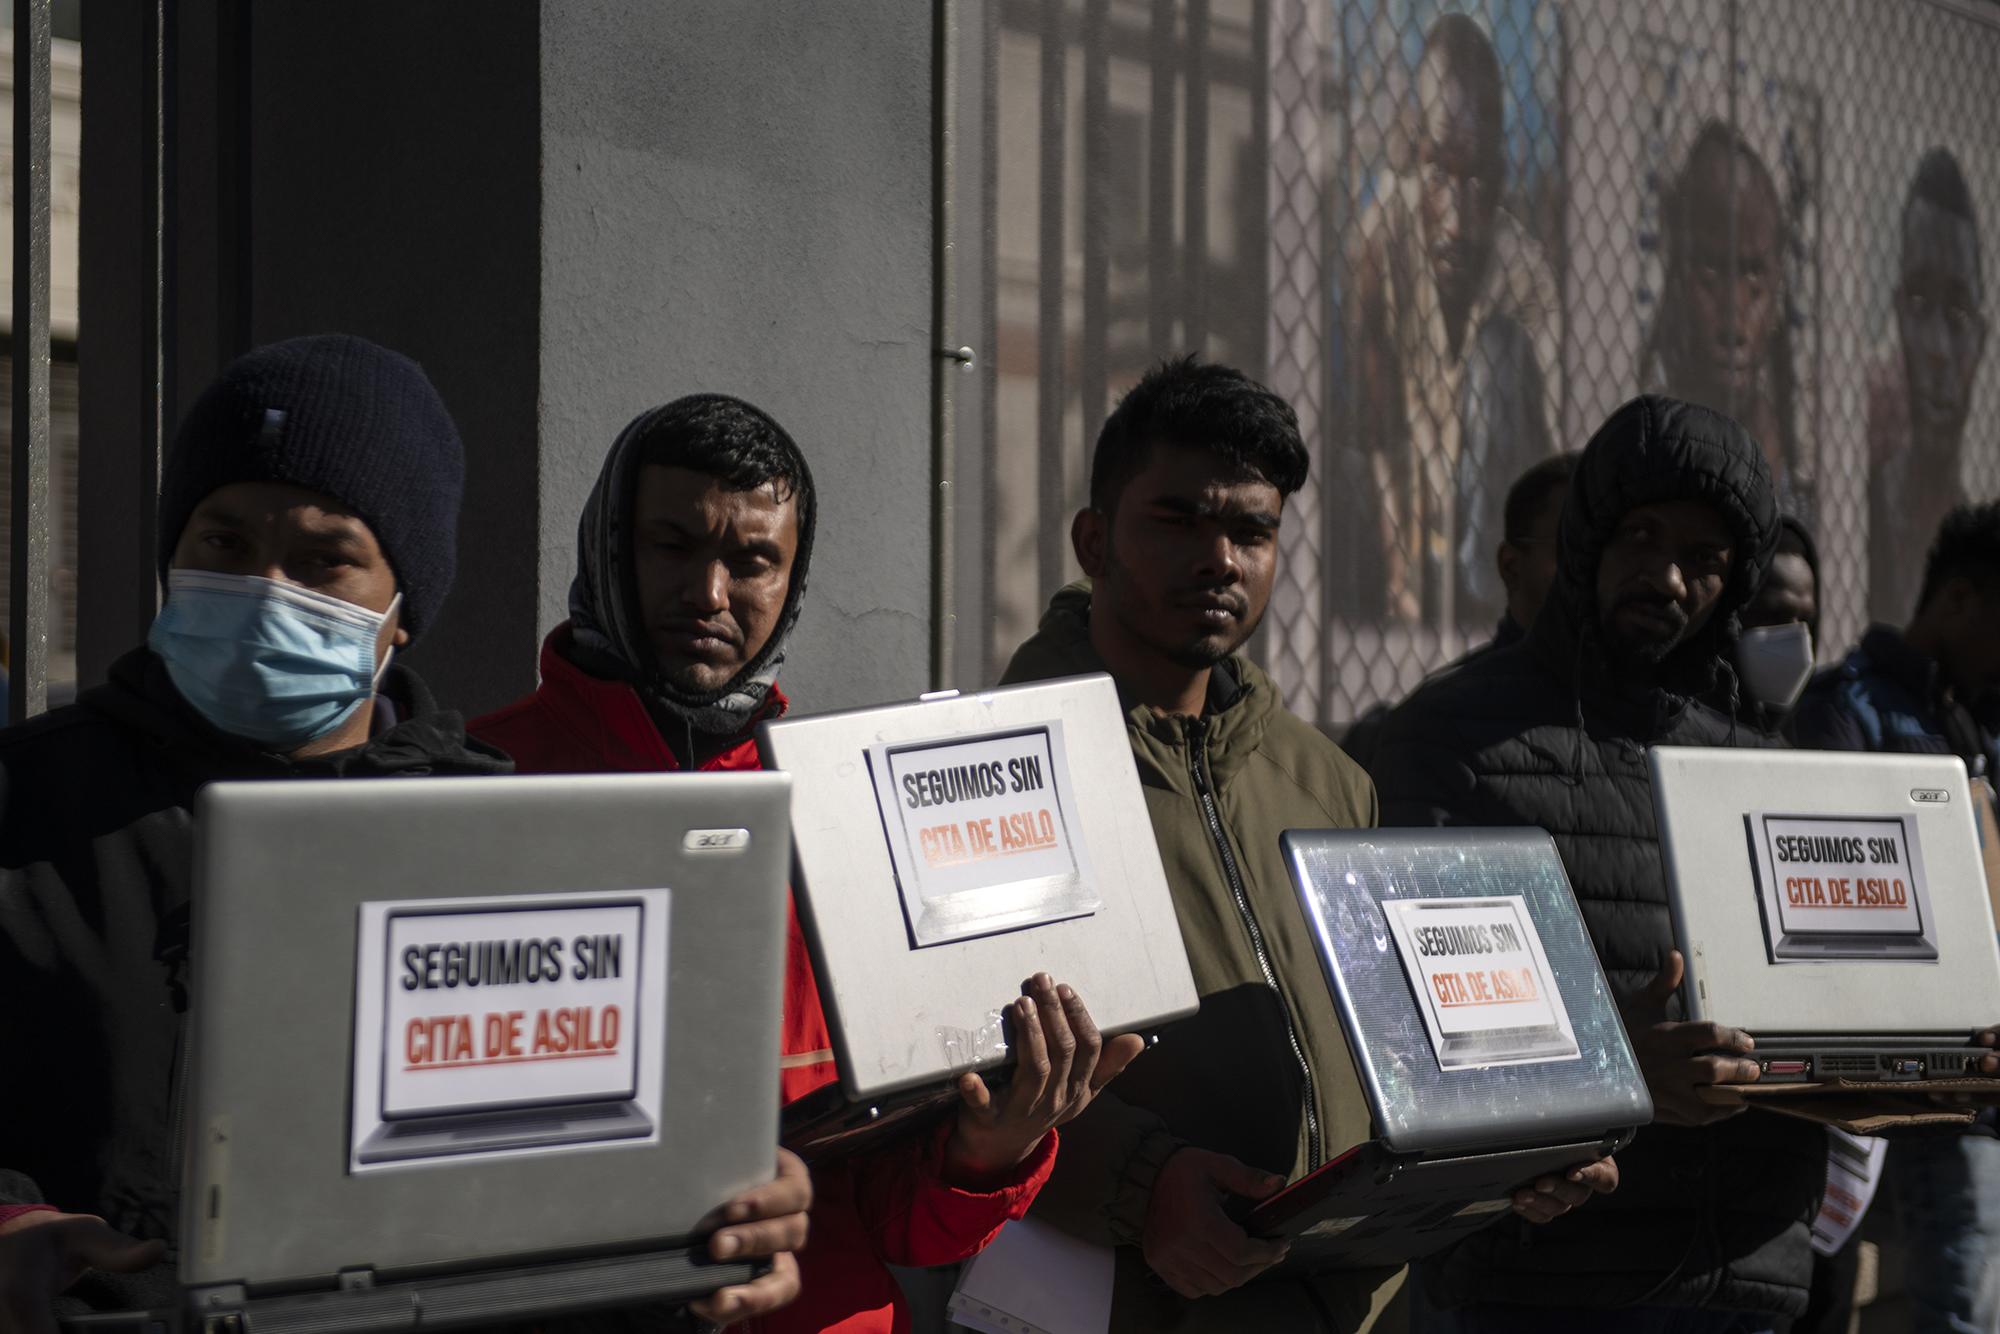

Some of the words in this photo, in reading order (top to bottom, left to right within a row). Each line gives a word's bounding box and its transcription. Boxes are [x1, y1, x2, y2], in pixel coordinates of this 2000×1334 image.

[903, 761, 1006, 809] SEGUIMOS
[1008, 755, 1043, 793] SIN
[919, 823, 968, 864] CITA
[966, 818, 998, 857] DE
[998, 808, 1056, 850] ASILO
[1776, 835, 1866, 863] SEGUIMOS
[1867, 837, 1898, 863] SIN
[1786, 876, 1825, 905] CITA
[1827, 877, 1853, 904] DE
[1857, 878, 1906, 905] ASILO
[1414, 925, 1493, 956] SEGUIMOS
[1490, 923, 1522, 952] SIN
[402, 937, 563, 990] SEGUIMOS
[572, 934, 621, 980] SIN
[1432, 972, 1471, 1003] CITA
[1466, 971, 1492, 1000] DE
[405, 1014, 475, 1064] CITA
[484, 1010, 524, 1057] DE
[531, 1003, 620, 1053] ASILO
